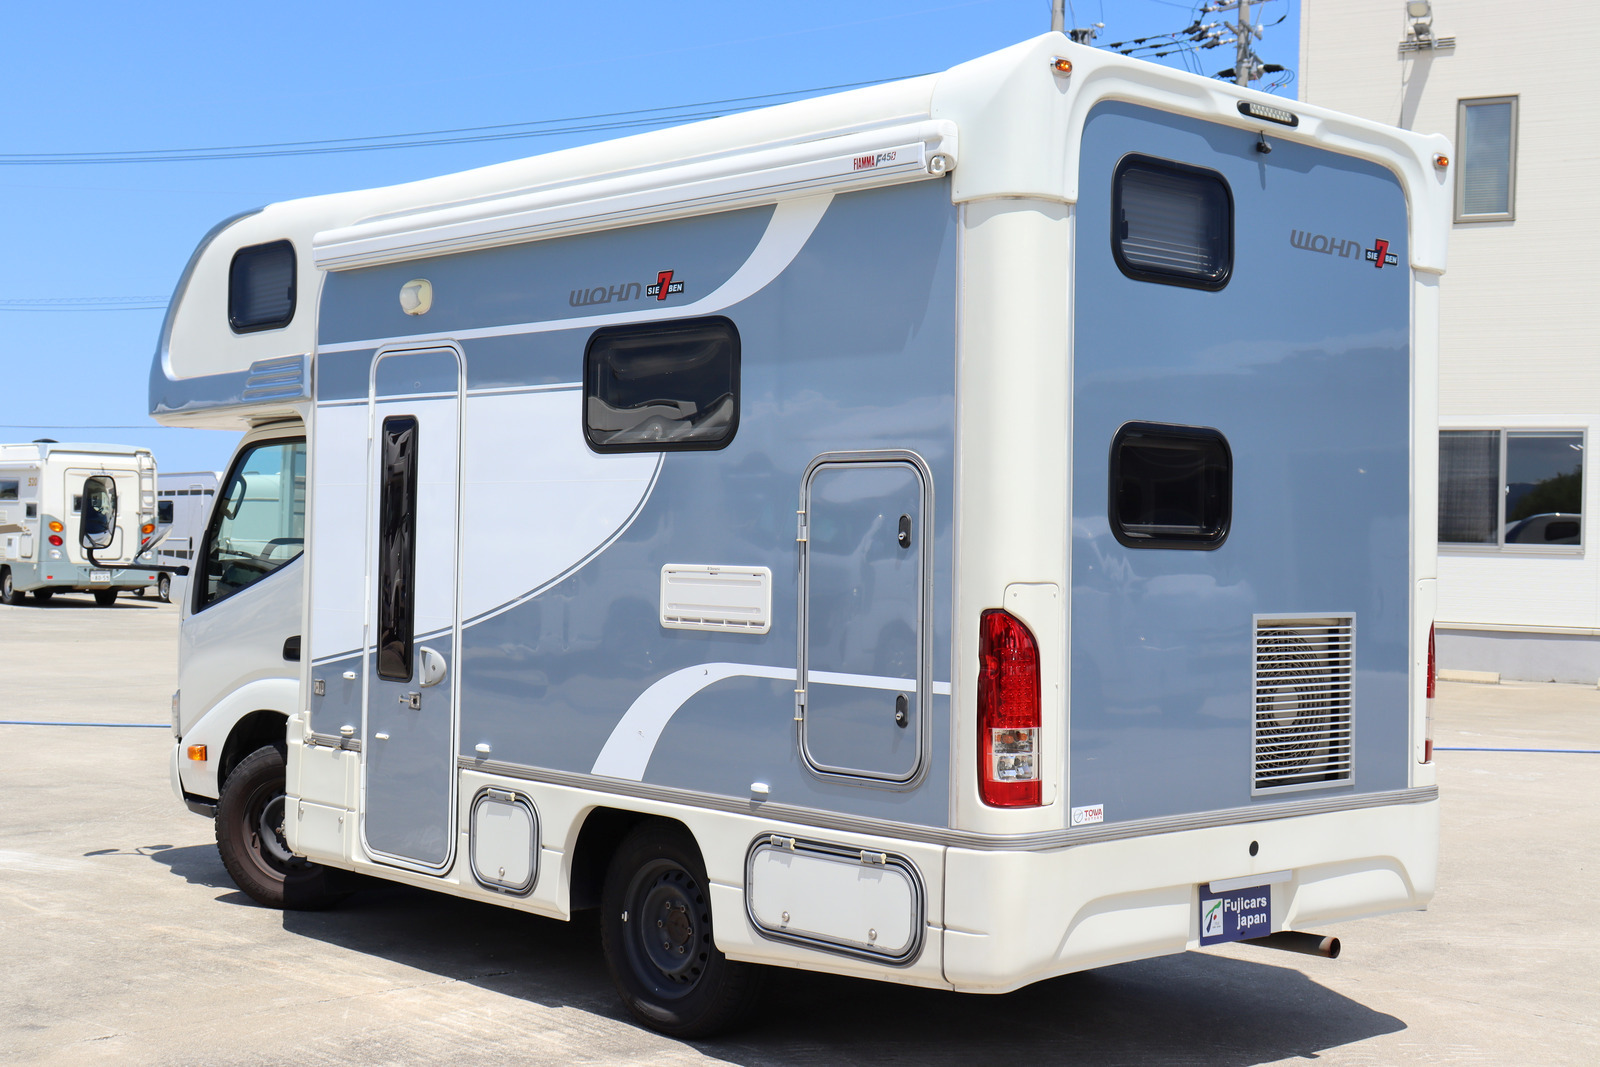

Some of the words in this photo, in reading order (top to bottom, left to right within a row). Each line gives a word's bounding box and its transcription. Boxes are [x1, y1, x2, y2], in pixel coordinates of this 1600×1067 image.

[853, 155, 875, 170] FIAMMA
[1084, 808, 1102, 817] TOWA
[1224, 897, 1267, 913] Fujicars
[1237, 913, 1267, 930] japan
